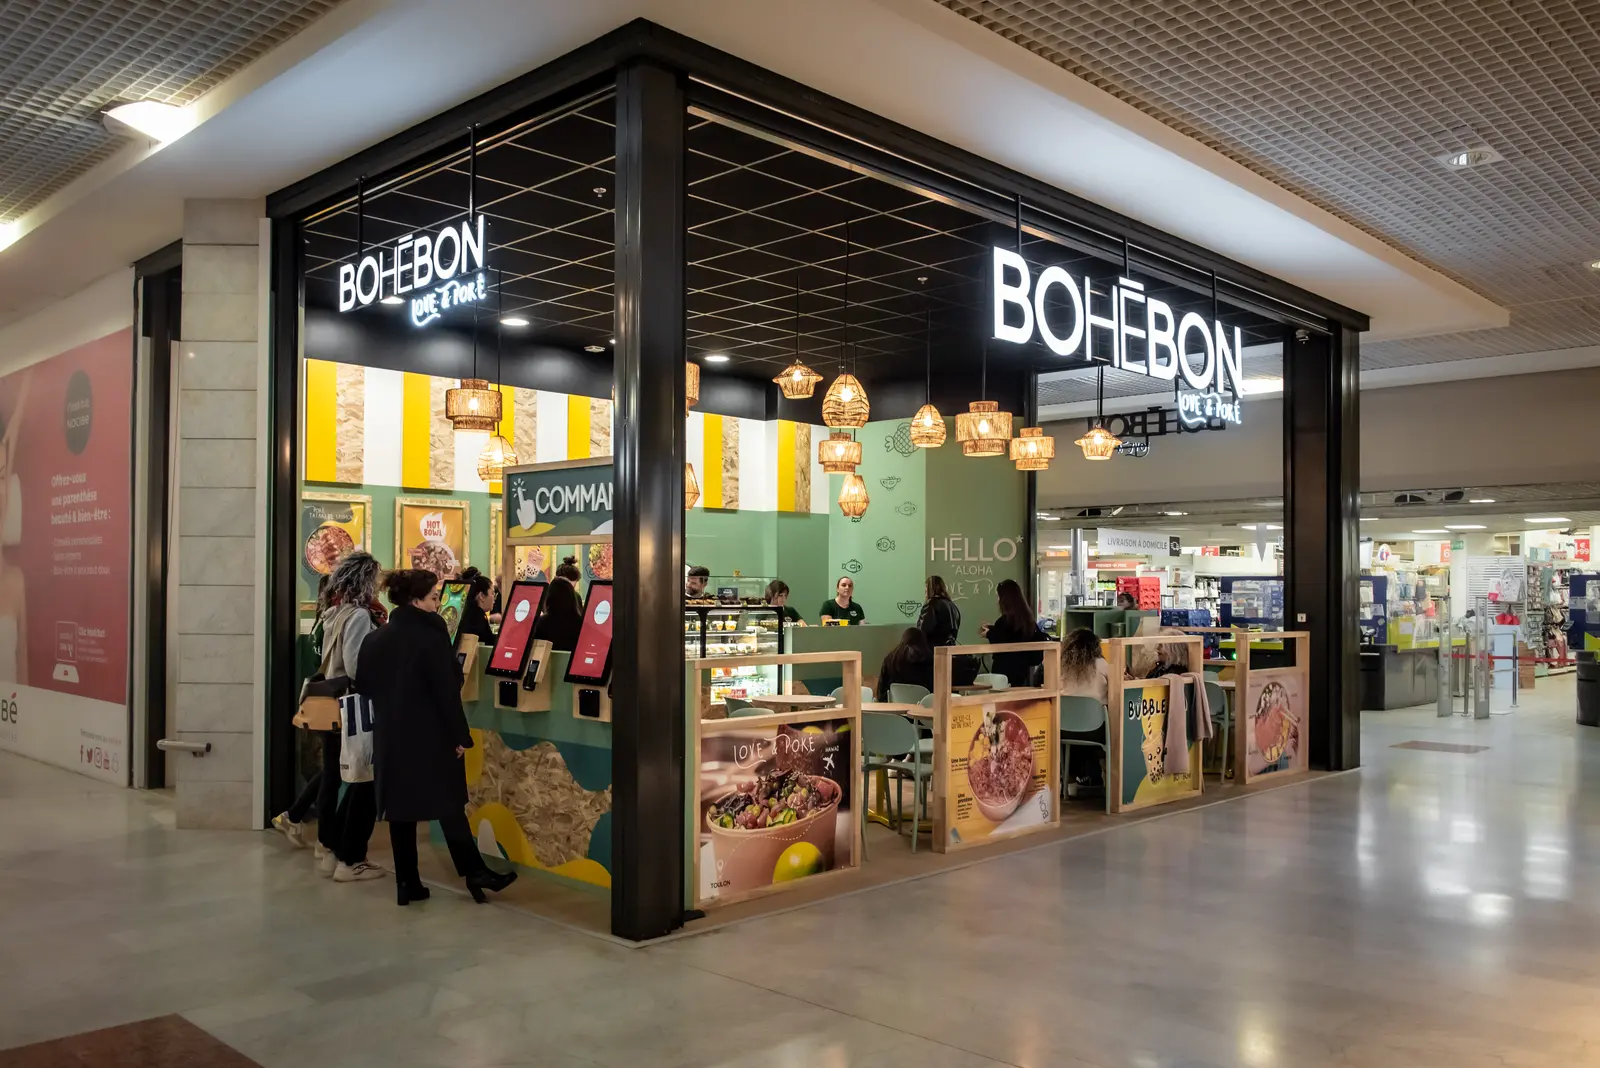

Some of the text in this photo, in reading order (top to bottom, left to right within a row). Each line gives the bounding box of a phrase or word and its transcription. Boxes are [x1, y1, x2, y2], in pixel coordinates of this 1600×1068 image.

[411, 293, 441, 327] LOVE
[1178, 391, 1206, 424] LOVE
[423, 528, 443, 537] BOWL
[426, 520, 441, 529] HOT
[1107, 538, 1138, 548] LIVRAISON
[1142, 541, 1168, 550] DOMICILE
[1129, 697, 1166, 720] BUBBLE
[734, 743, 767, 770] LOVE
[710, 879, 731, 889] TOULON
